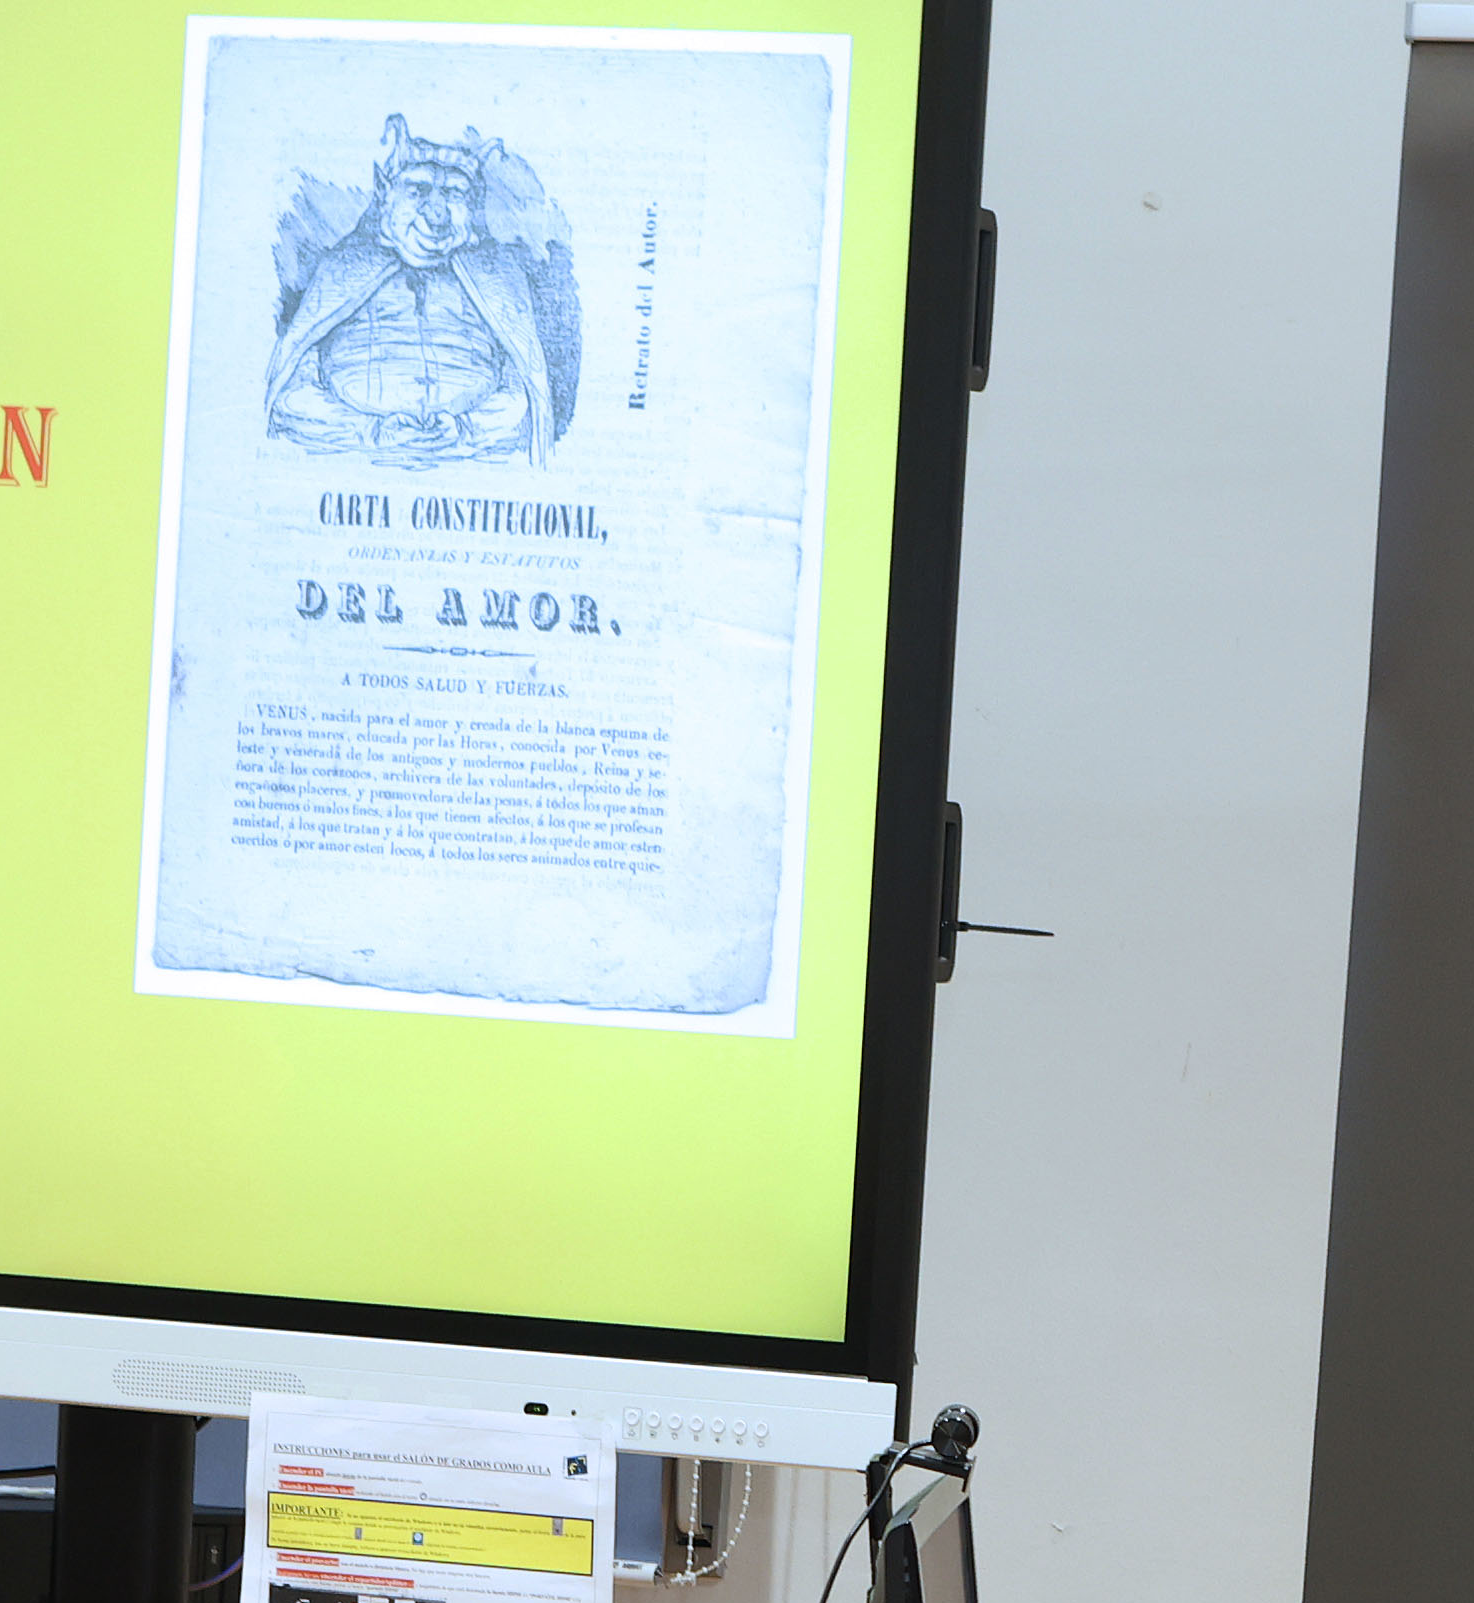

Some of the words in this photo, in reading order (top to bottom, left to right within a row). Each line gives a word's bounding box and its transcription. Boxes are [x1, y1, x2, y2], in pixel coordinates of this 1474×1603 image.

[638, 201, 658, 275] Autor.
[635, 285, 653, 317] del
[629, 325, 651, 409] Retrato
[319, 491, 391, 529] CARTA
[411, 495, 609, 545] CONSTITUCIONAL,
[463, 550, 475, 565] Y
[480, 552, 582, 571] ESTATUTOS
[296, 579, 404, 625] DEL
[342, 673, 352, 687] A
[360, 674, 409, 691] TODOS
[416, 676, 467, 694] SALUD
[477, 679, 487, 694] Y
[273, 1443, 351, 1457] INSTRUCCIONES
[437, 1455, 449, 1467] DE
[451, 1457, 492, 1470] GRADOS
[494, 1461, 524, 1473] COMO
[526, 1463, 552, 1476] AULA
